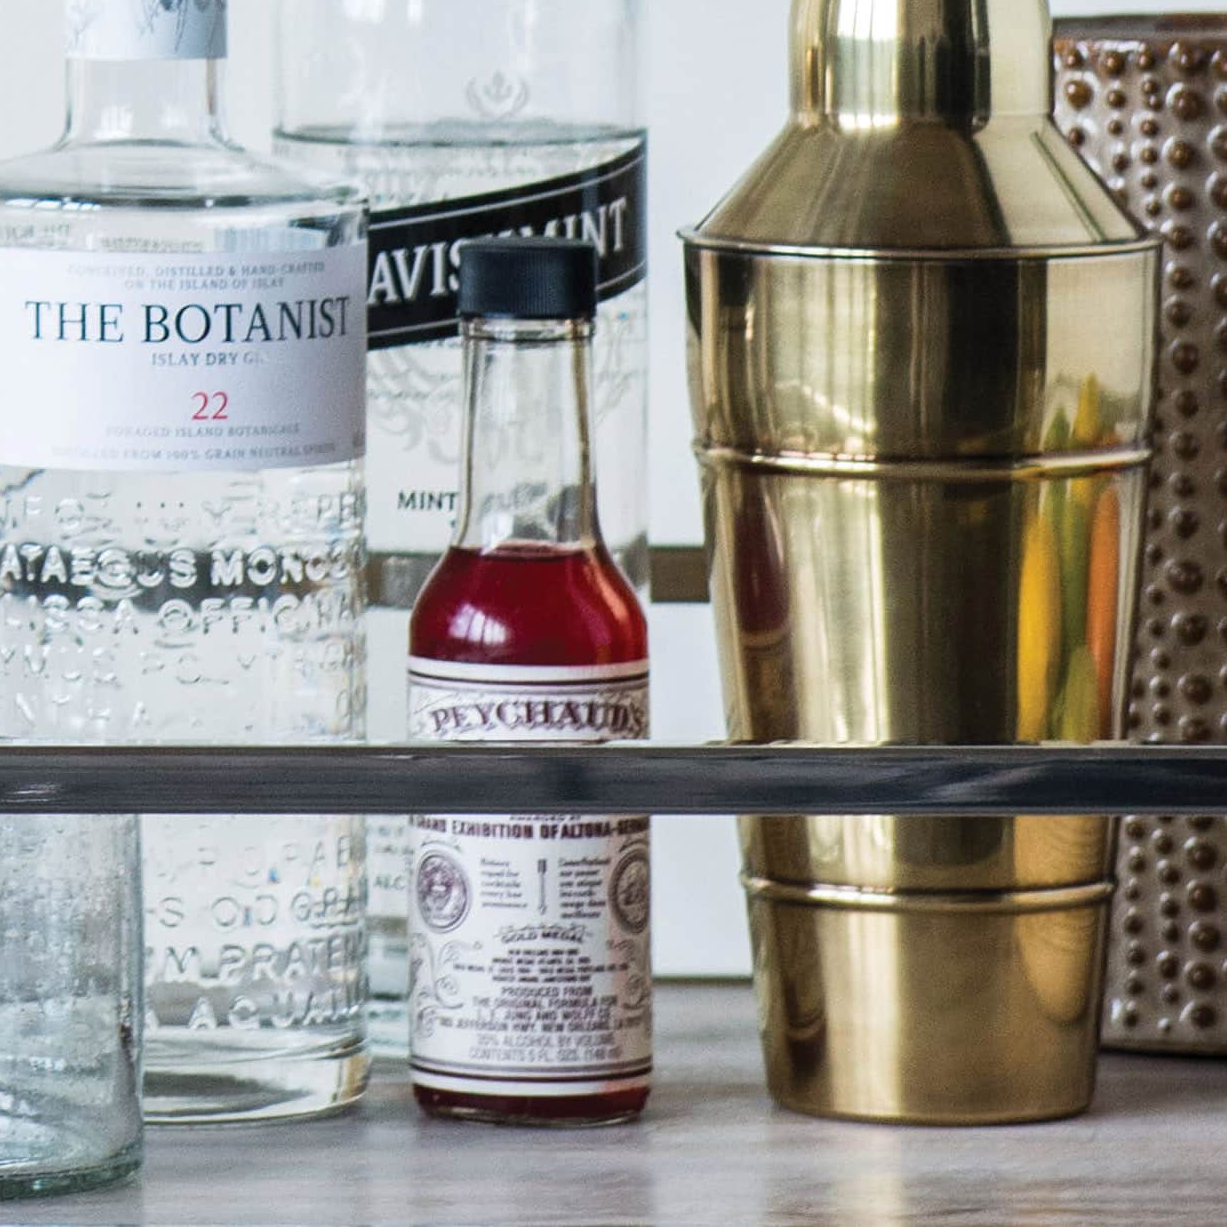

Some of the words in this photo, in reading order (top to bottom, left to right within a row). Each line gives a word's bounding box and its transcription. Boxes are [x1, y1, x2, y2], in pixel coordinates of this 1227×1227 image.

[25, 299, 125, 343] THE
[140, 295, 351, 345] BOTANIST
[151, 351, 200, 367] ISLAY
[205, 351, 239, 366] DRY
[190, 391, 230, 421] 22
[397, 490, 460, 512] MINT
[452, 821, 534, 839] EXHIBITION
[540, 824, 558, 839] OF
